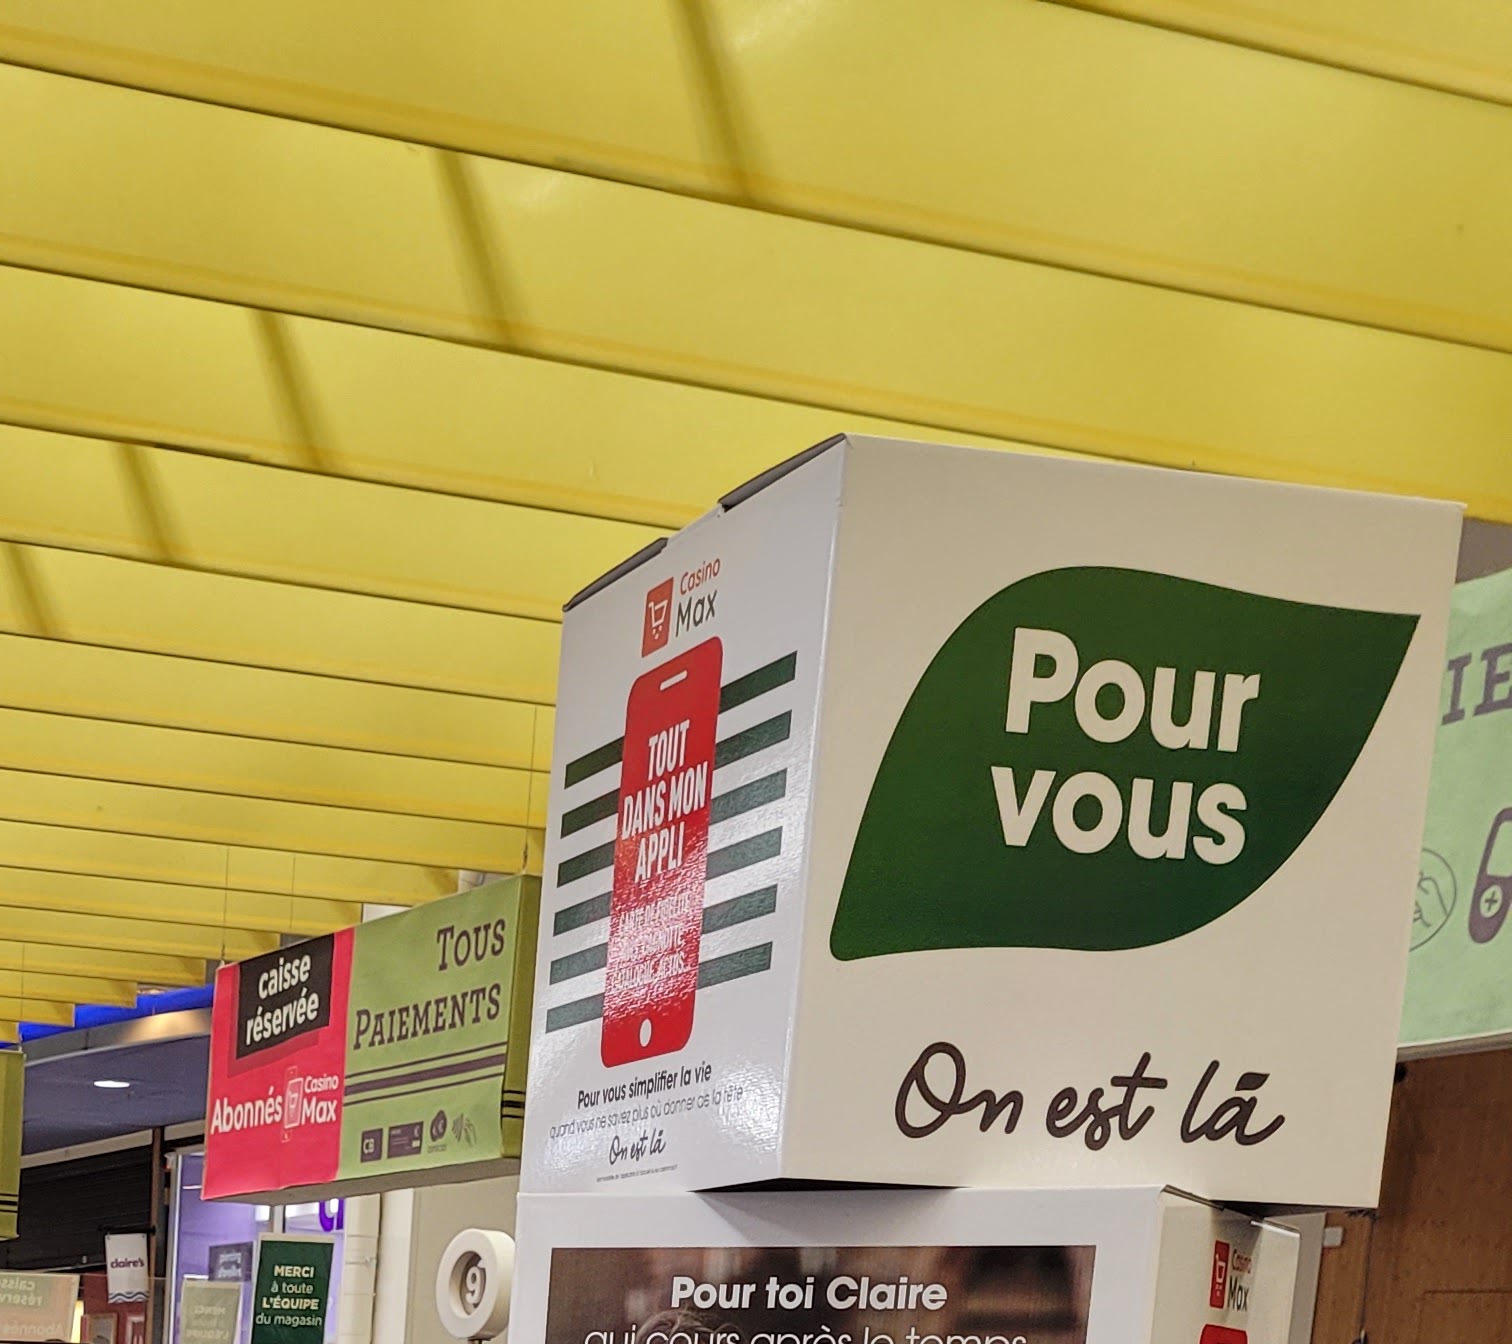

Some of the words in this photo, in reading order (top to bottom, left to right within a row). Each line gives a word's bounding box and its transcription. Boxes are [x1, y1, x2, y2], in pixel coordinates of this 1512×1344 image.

[680, 558, 721, 596] Casino
[676, 590, 718, 638] Max
[1004, 626, 1261, 752] Pour
[648, 719, 690, 782] TOUT
[621, 779, 666, 840] DANS
[667, 761, 708, 822] MON
[991, 766, 1248, 866] vous
[634, 822, 686, 885] APPLI
[437, 918, 506, 972] TOUS
[258, 954, 312, 1000] caisse
[245, 986, 320, 1046] réservée
[353, 983, 501, 1050] PAIEMENTS
[304, 1072, 339, 1095] Casino
[577, 1087, 600, 1110] Pour
[602, 1082, 627, 1103] vous
[628, 1070, 678, 1099] simplifier
[680, 1066, 691, 1086] la
[695, 1060, 712, 1083] vie
[895, 1042, 1023, 1139] On
[1044, 1050, 1168, 1151] est
[210, 1086, 284, 1135] Abonnés
[301, 1097, 337, 1126] Max
[609, 1135, 628, 1165] On
[630, 1131, 648, 1162] est
[110, 1257, 145, 1269] claire's
[273, 1264, 315, 1279] MERCI
[465, 1264, 487, 1306] 9
[262, 1294, 319, 1310] L'ÉQUIPE
[271, 1281, 279, 1295] à
[281, 1282, 313, 1295] toute
[671, 1277, 757, 1311] Pour
[765, 1277, 813, 1310] toi
[825, 1276, 948, 1310] Claire
[1227, 1275, 1248, 1311] Max
[256, 1312, 271, 1326] du
[273, 1313, 323, 1329] magasin
